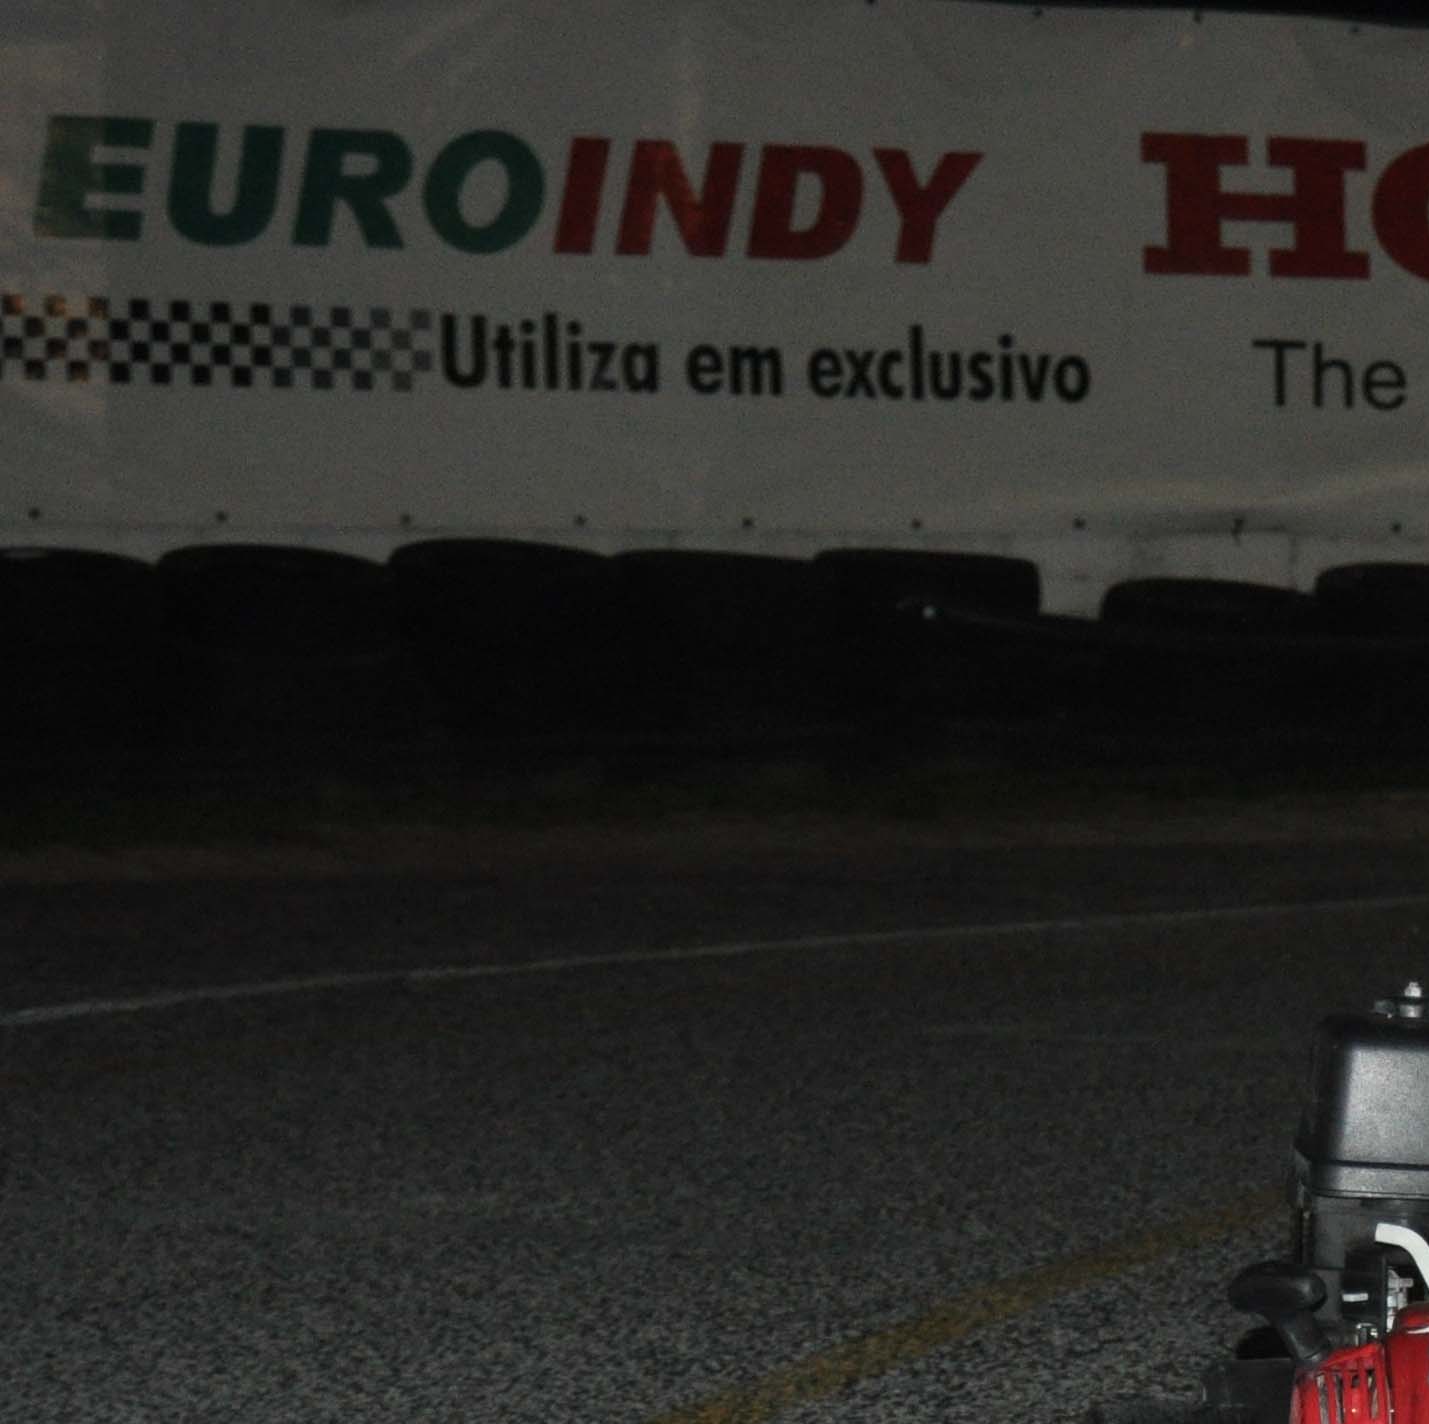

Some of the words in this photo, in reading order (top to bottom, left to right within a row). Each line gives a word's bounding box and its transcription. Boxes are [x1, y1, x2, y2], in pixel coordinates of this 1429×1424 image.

[33, 114, 986, 264] EUROINDY
[440, 309, 660, 394] Utiliza
[685, 341, 784, 398] em
[807, 325, 1092, 404] exclusivo
[1251, 337, 1408, 411] The
